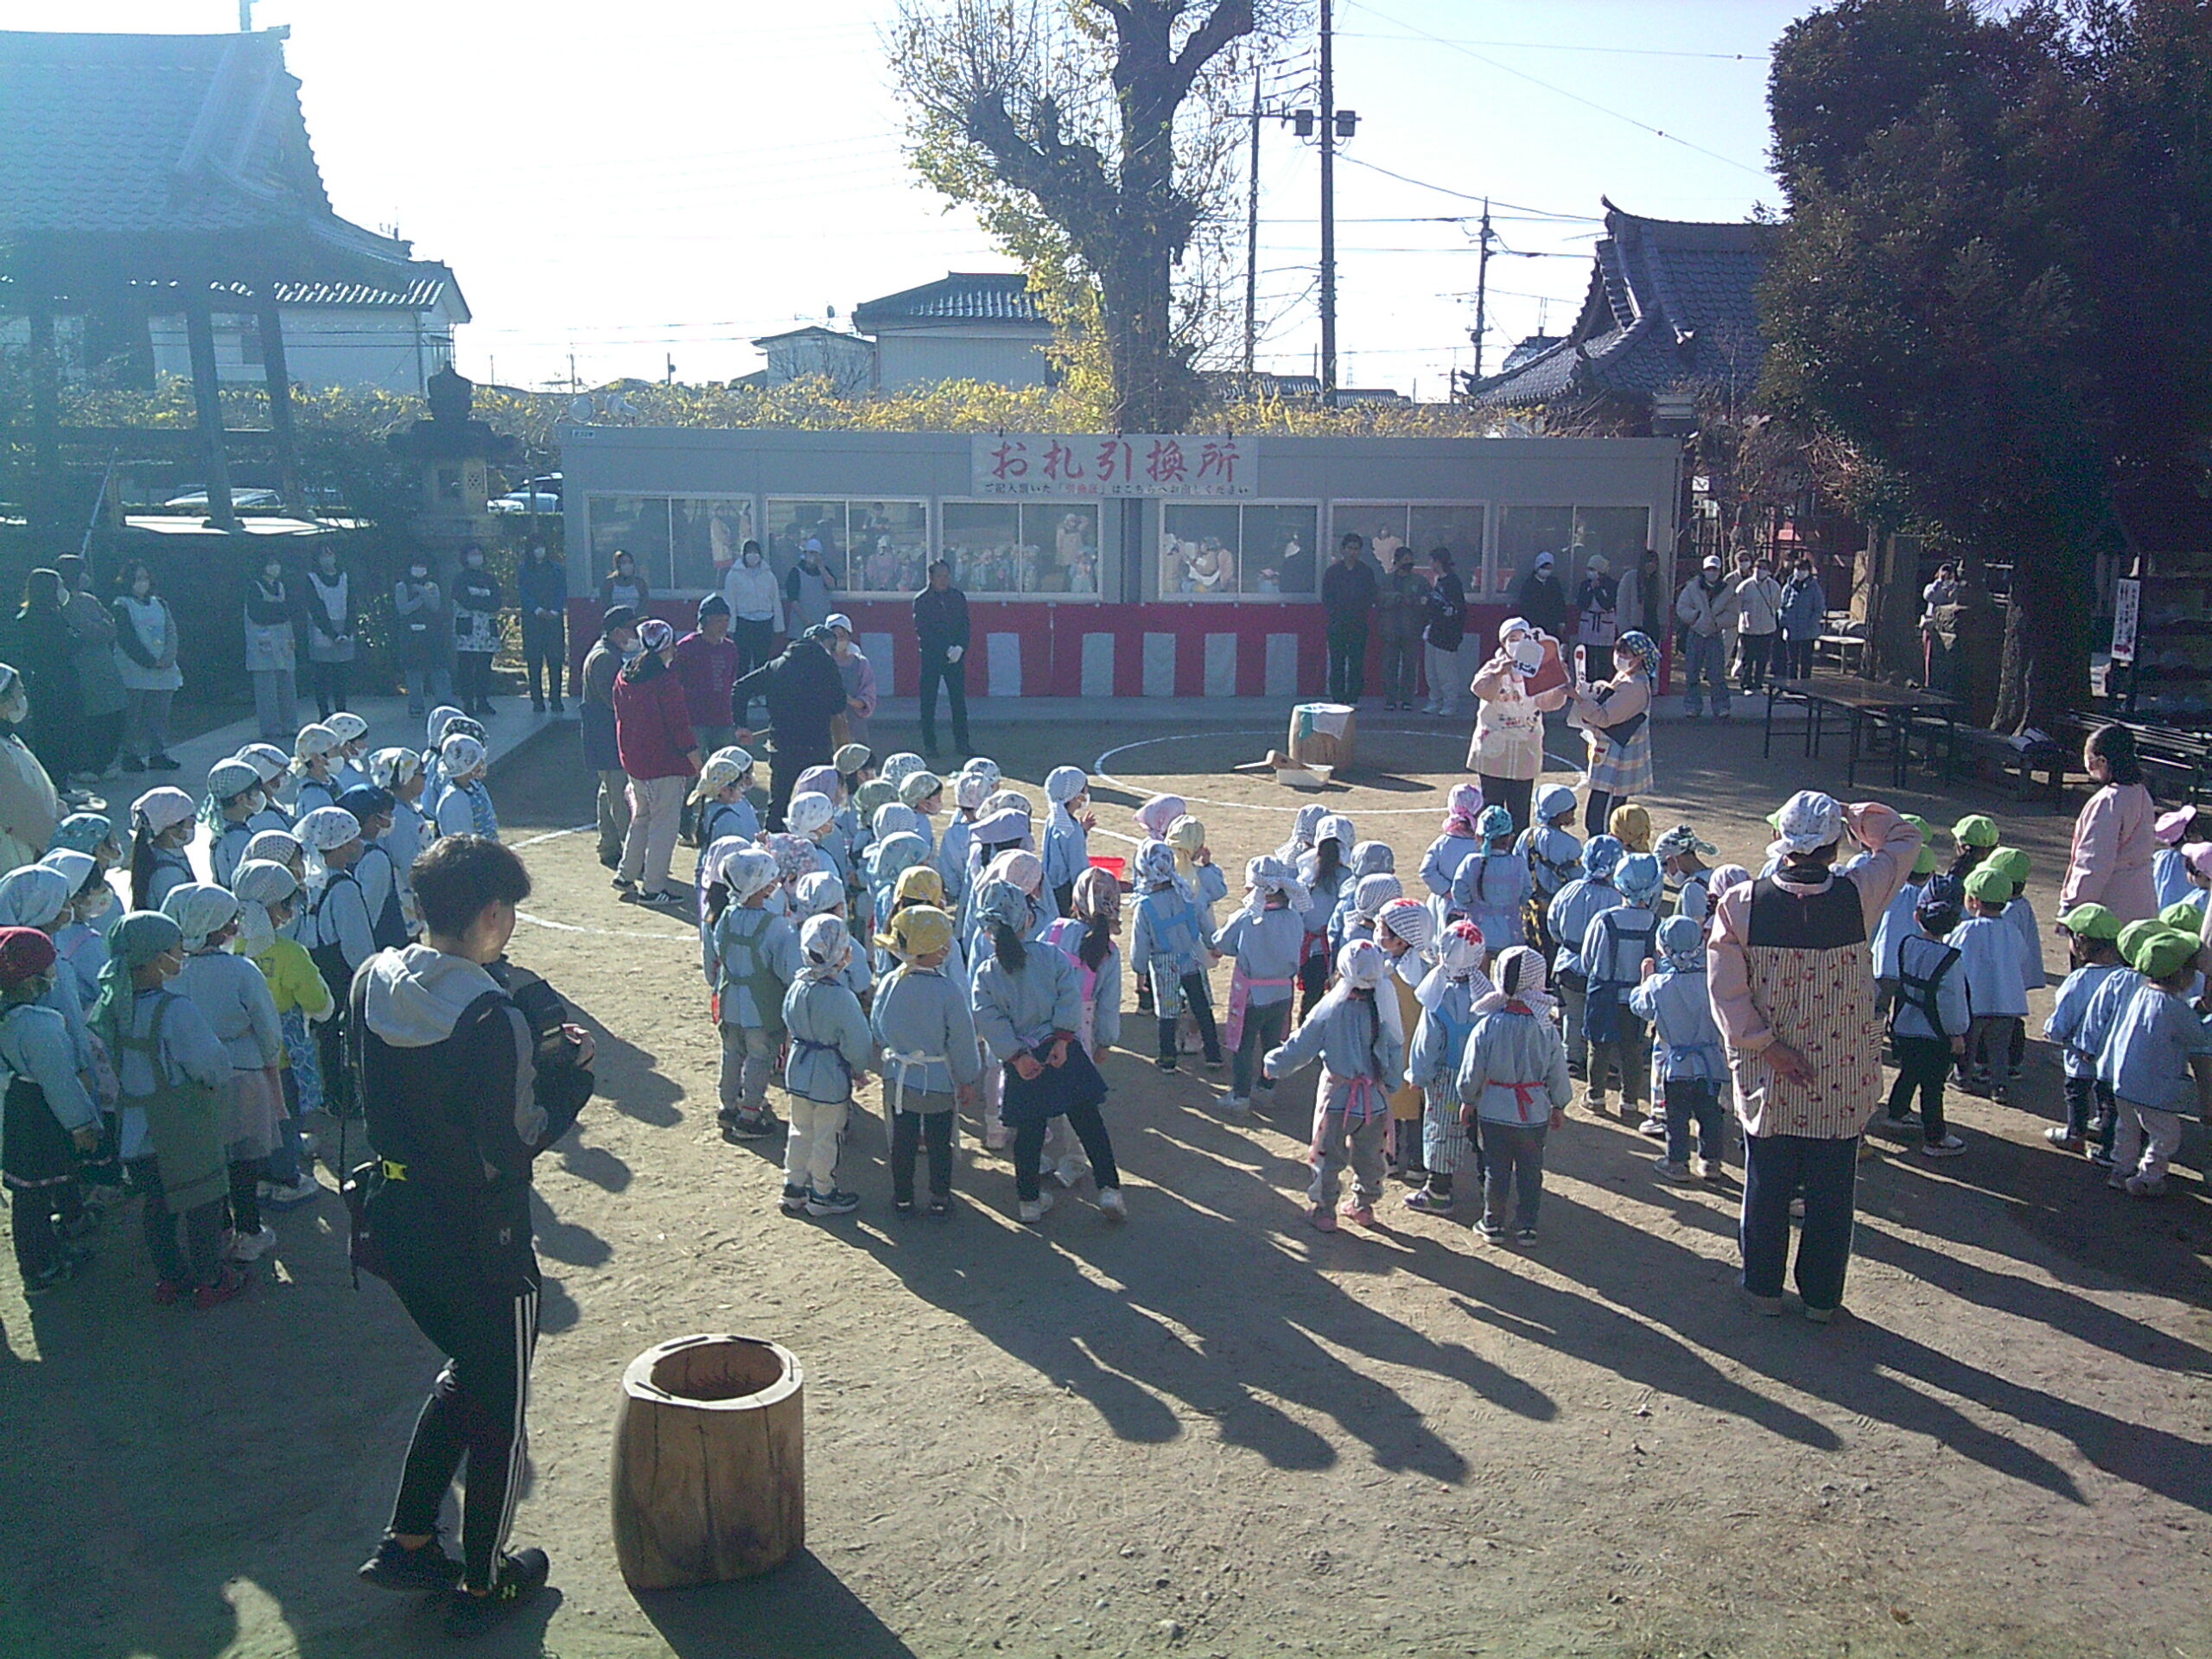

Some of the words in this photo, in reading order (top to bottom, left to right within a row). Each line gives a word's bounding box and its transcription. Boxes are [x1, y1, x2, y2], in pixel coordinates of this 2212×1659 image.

[991, 439, 1240, 483] お札引換所
